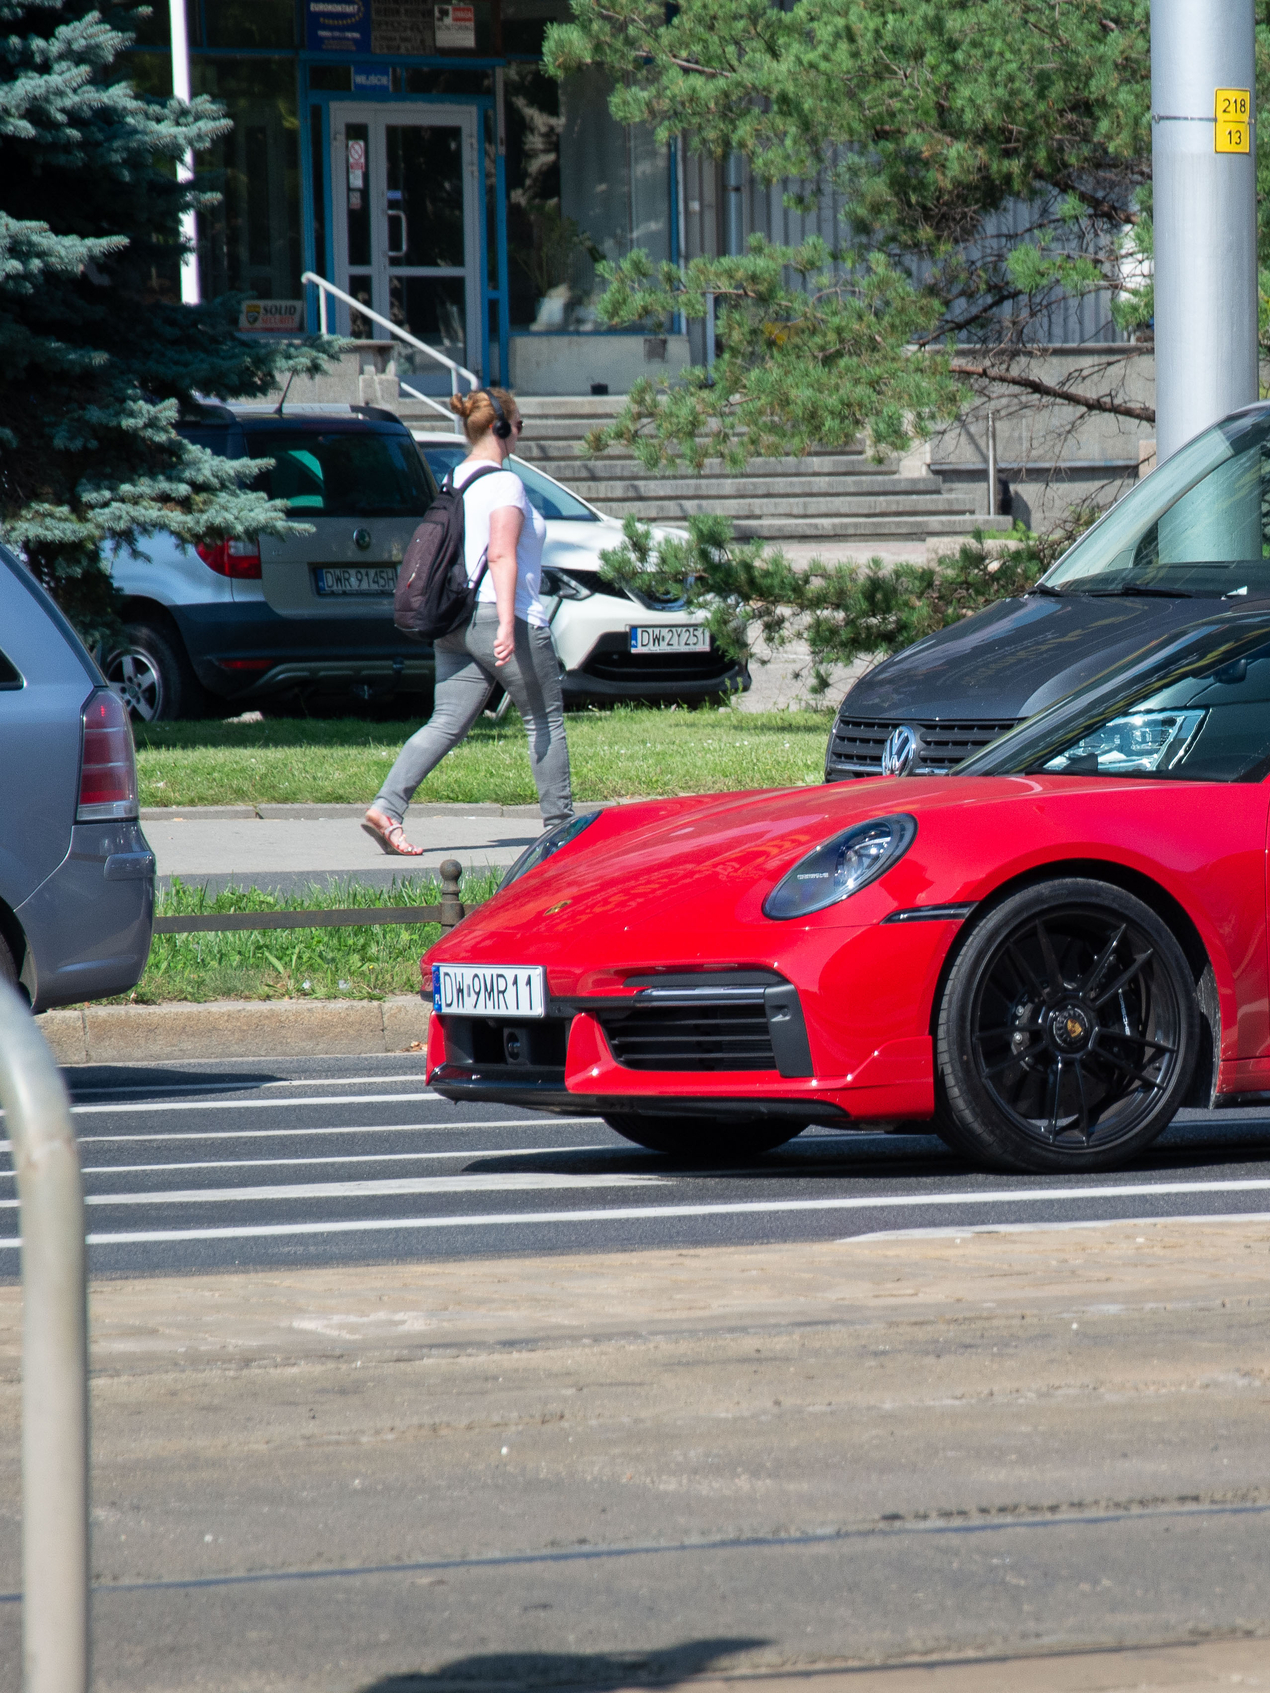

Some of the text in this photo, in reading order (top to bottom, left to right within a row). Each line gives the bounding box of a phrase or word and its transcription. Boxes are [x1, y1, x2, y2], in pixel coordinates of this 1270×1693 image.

[1222, 98, 1246, 114] 218
[1228, 130, 1242, 145] 13
[263, 304, 296, 315] SOLID
[262, 316, 295, 325] SECURITY
[324, 570, 396, 588] DWR 9145H
[641, 628, 706, 647] DW 2Y251
[443, 971, 533, 1011] DW 9MR11
